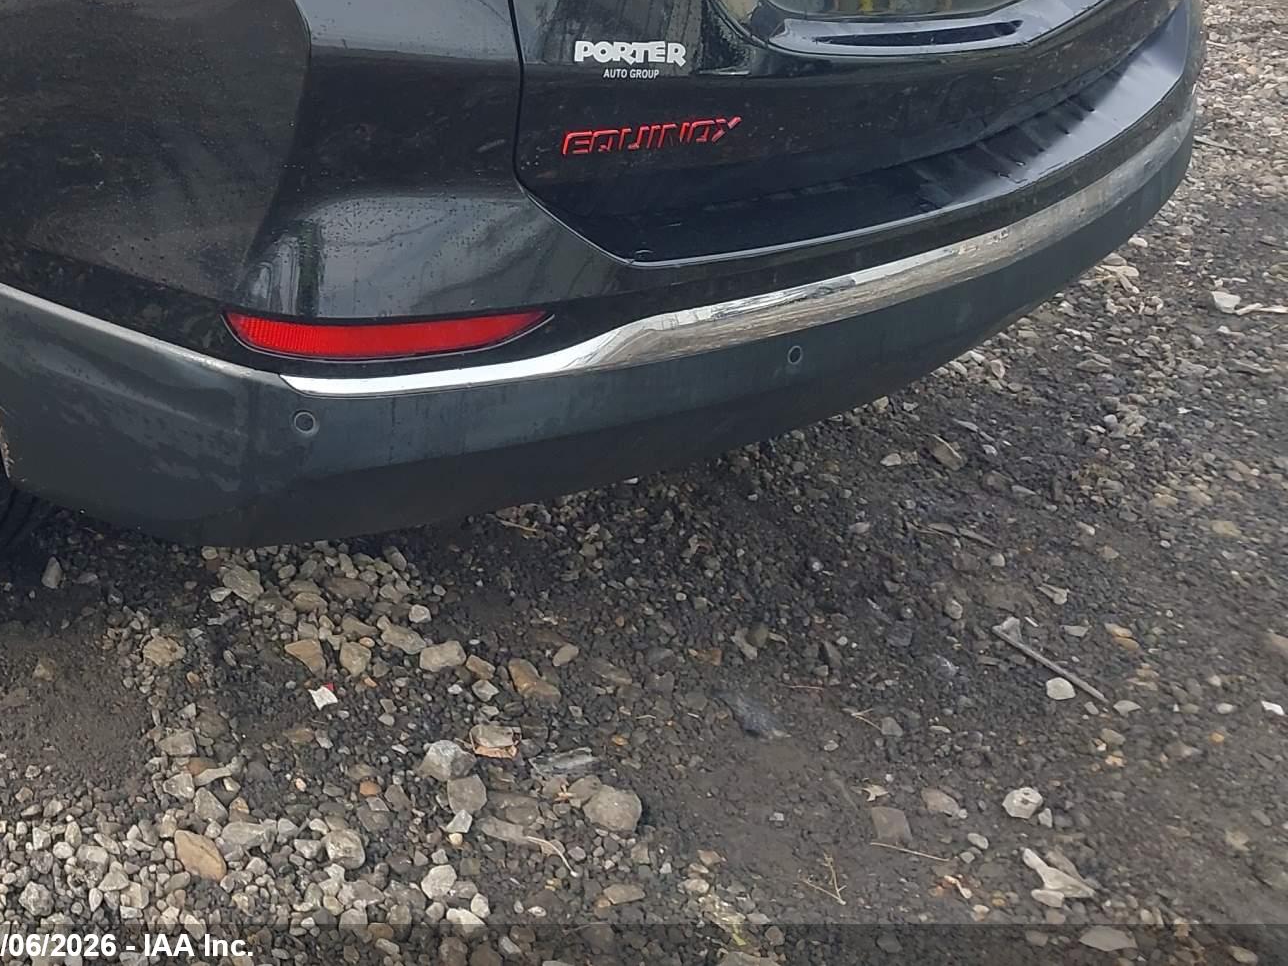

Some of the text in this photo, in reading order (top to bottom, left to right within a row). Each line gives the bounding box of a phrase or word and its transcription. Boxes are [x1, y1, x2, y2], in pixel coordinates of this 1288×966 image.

[573, 40, 687, 67] PORTER
[603, 68, 660, 80] AUTO GROUP
[561, 116, 743, 155] EQUINOX
